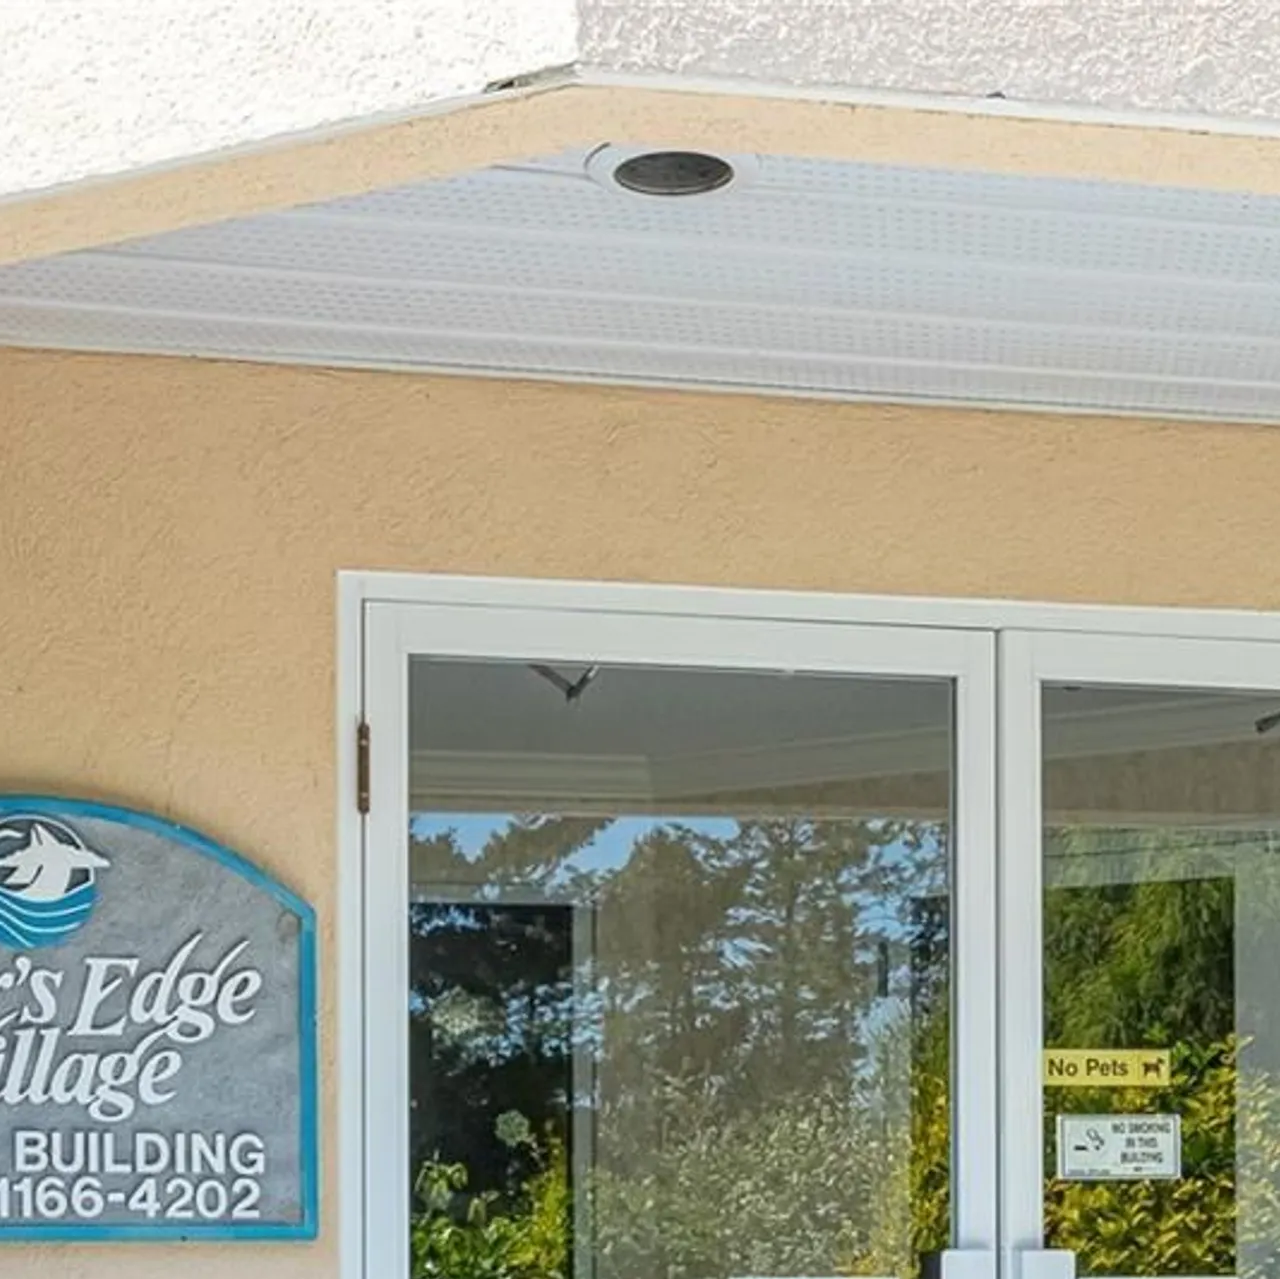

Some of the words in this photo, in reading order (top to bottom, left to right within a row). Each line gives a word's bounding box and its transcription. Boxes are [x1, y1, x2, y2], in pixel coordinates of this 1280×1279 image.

[66, 931, 263, 1042] Edge
[1048, 1057, 1078, 1076] No
[1086, 1057, 1129, 1076] Pets
[1129, 1123, 1171, 1134] SMOKING
[14, 1133, 266, 1174] BUILDING
[1120, 1152, 1163, 1164] BUILDING
